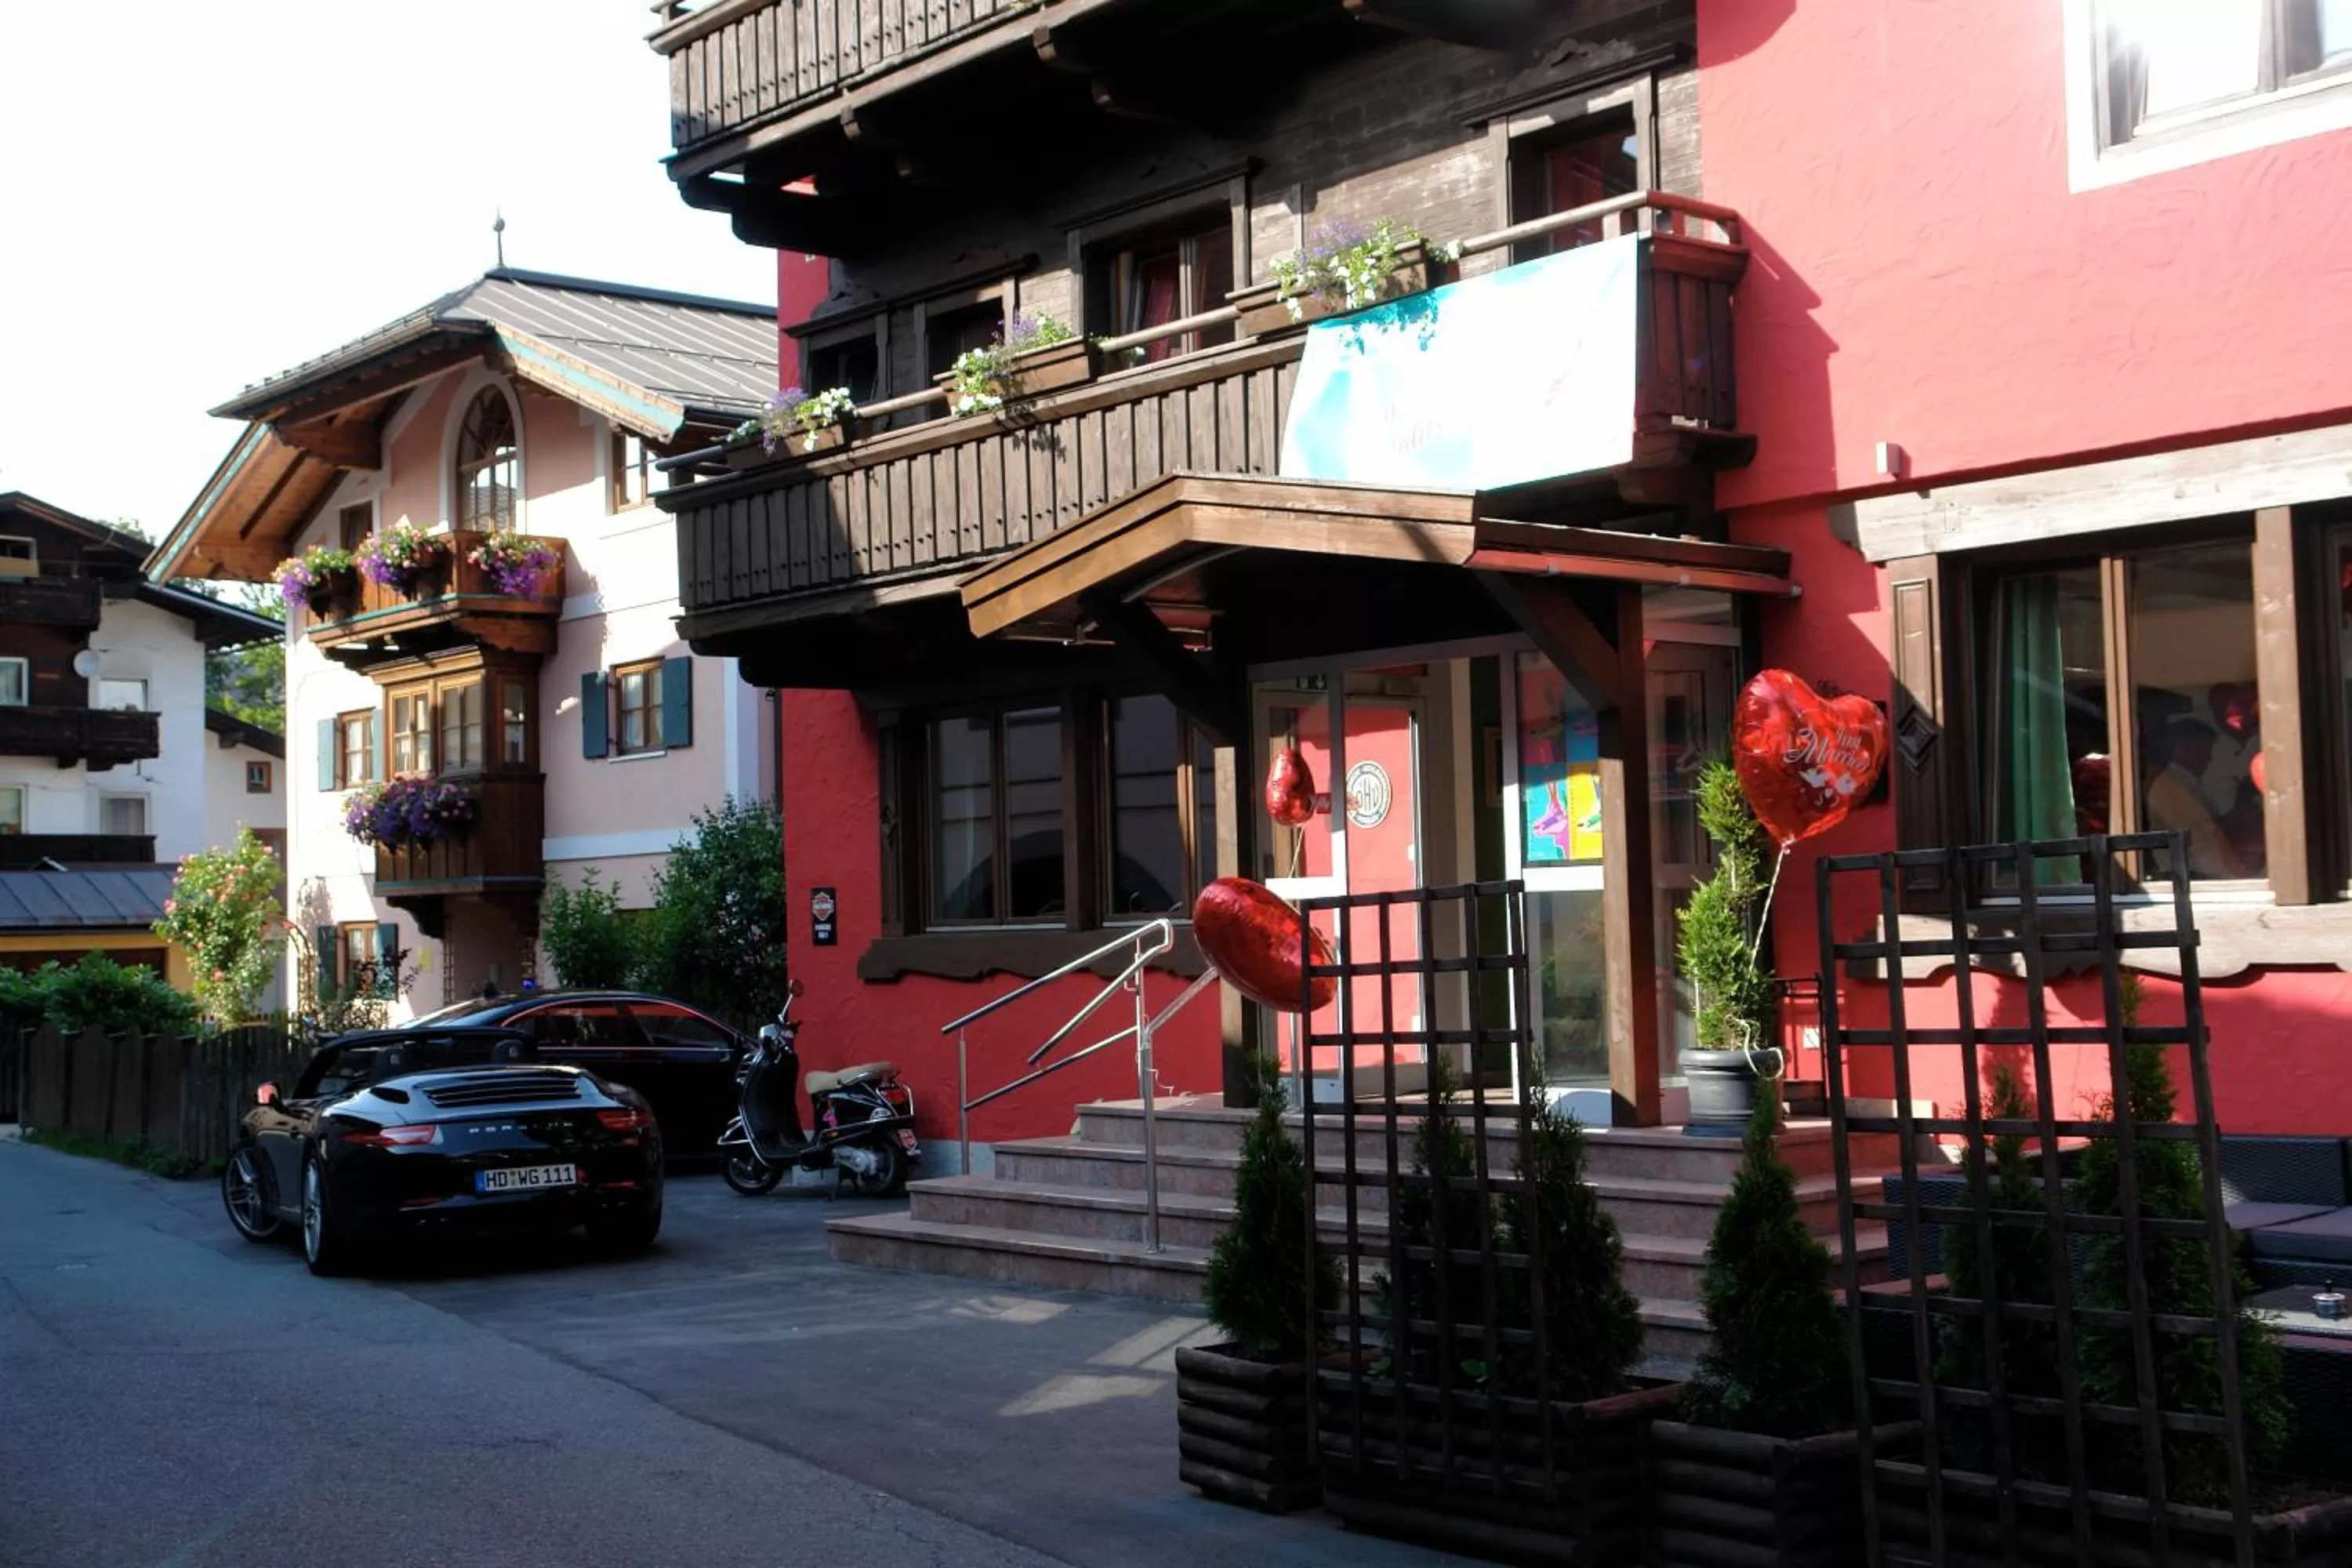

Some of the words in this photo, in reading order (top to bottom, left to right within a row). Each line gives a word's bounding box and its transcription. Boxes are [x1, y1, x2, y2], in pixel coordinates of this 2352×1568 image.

[485, 1171, 508, 1189] HD
[517, 1169, 540, 1185] WG
[543, 1166, 573, 1183] 111
